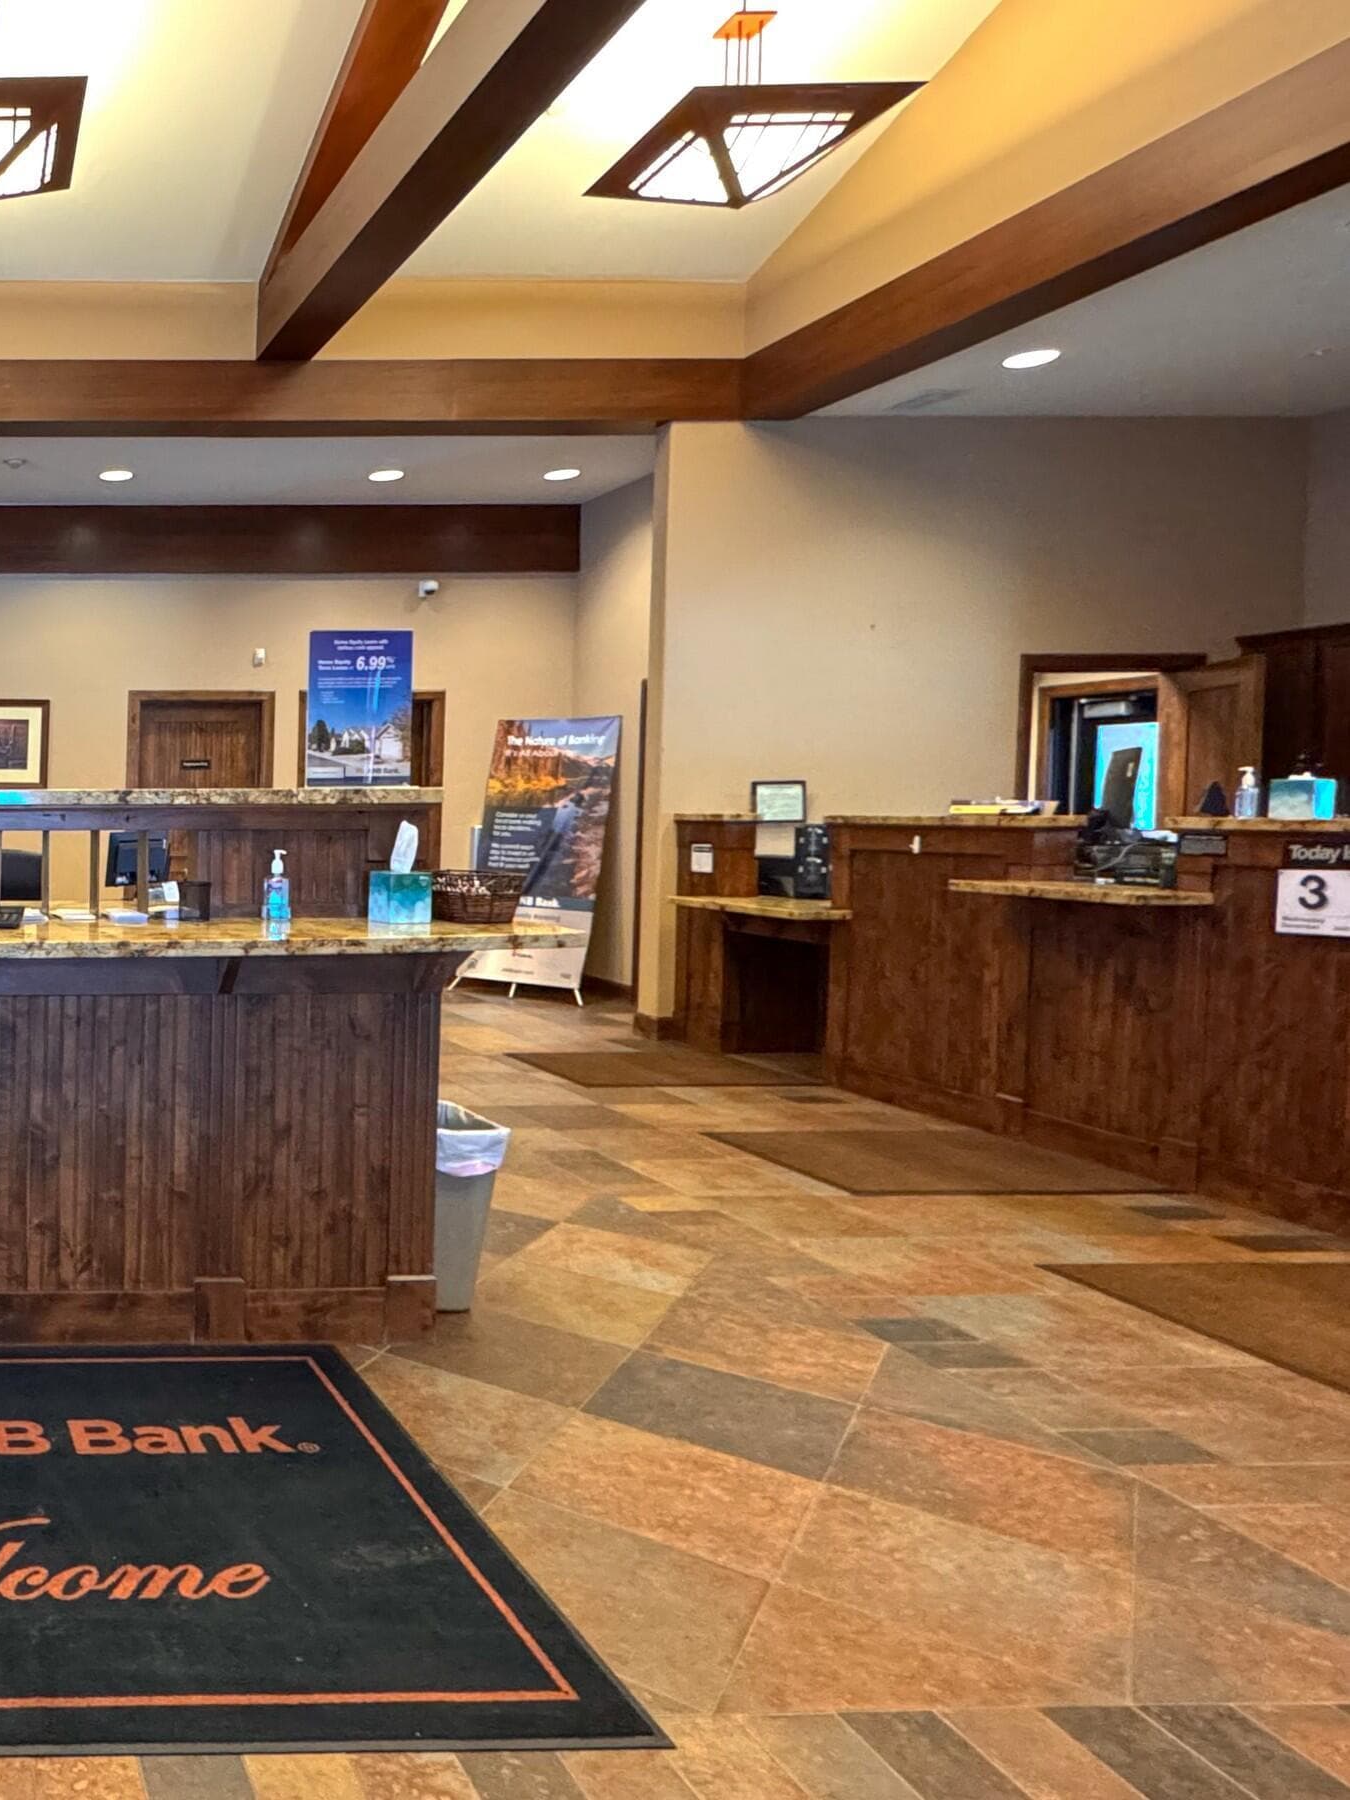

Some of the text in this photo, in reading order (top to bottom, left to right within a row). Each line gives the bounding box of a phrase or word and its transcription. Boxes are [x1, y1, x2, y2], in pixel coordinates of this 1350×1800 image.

[507, 734, 607, 746] The Nature of Banking
[1288, 843, 1342, 864] Today
[1298, 874, 1329, 911] 3
[519, 896, 534, 906] NB
